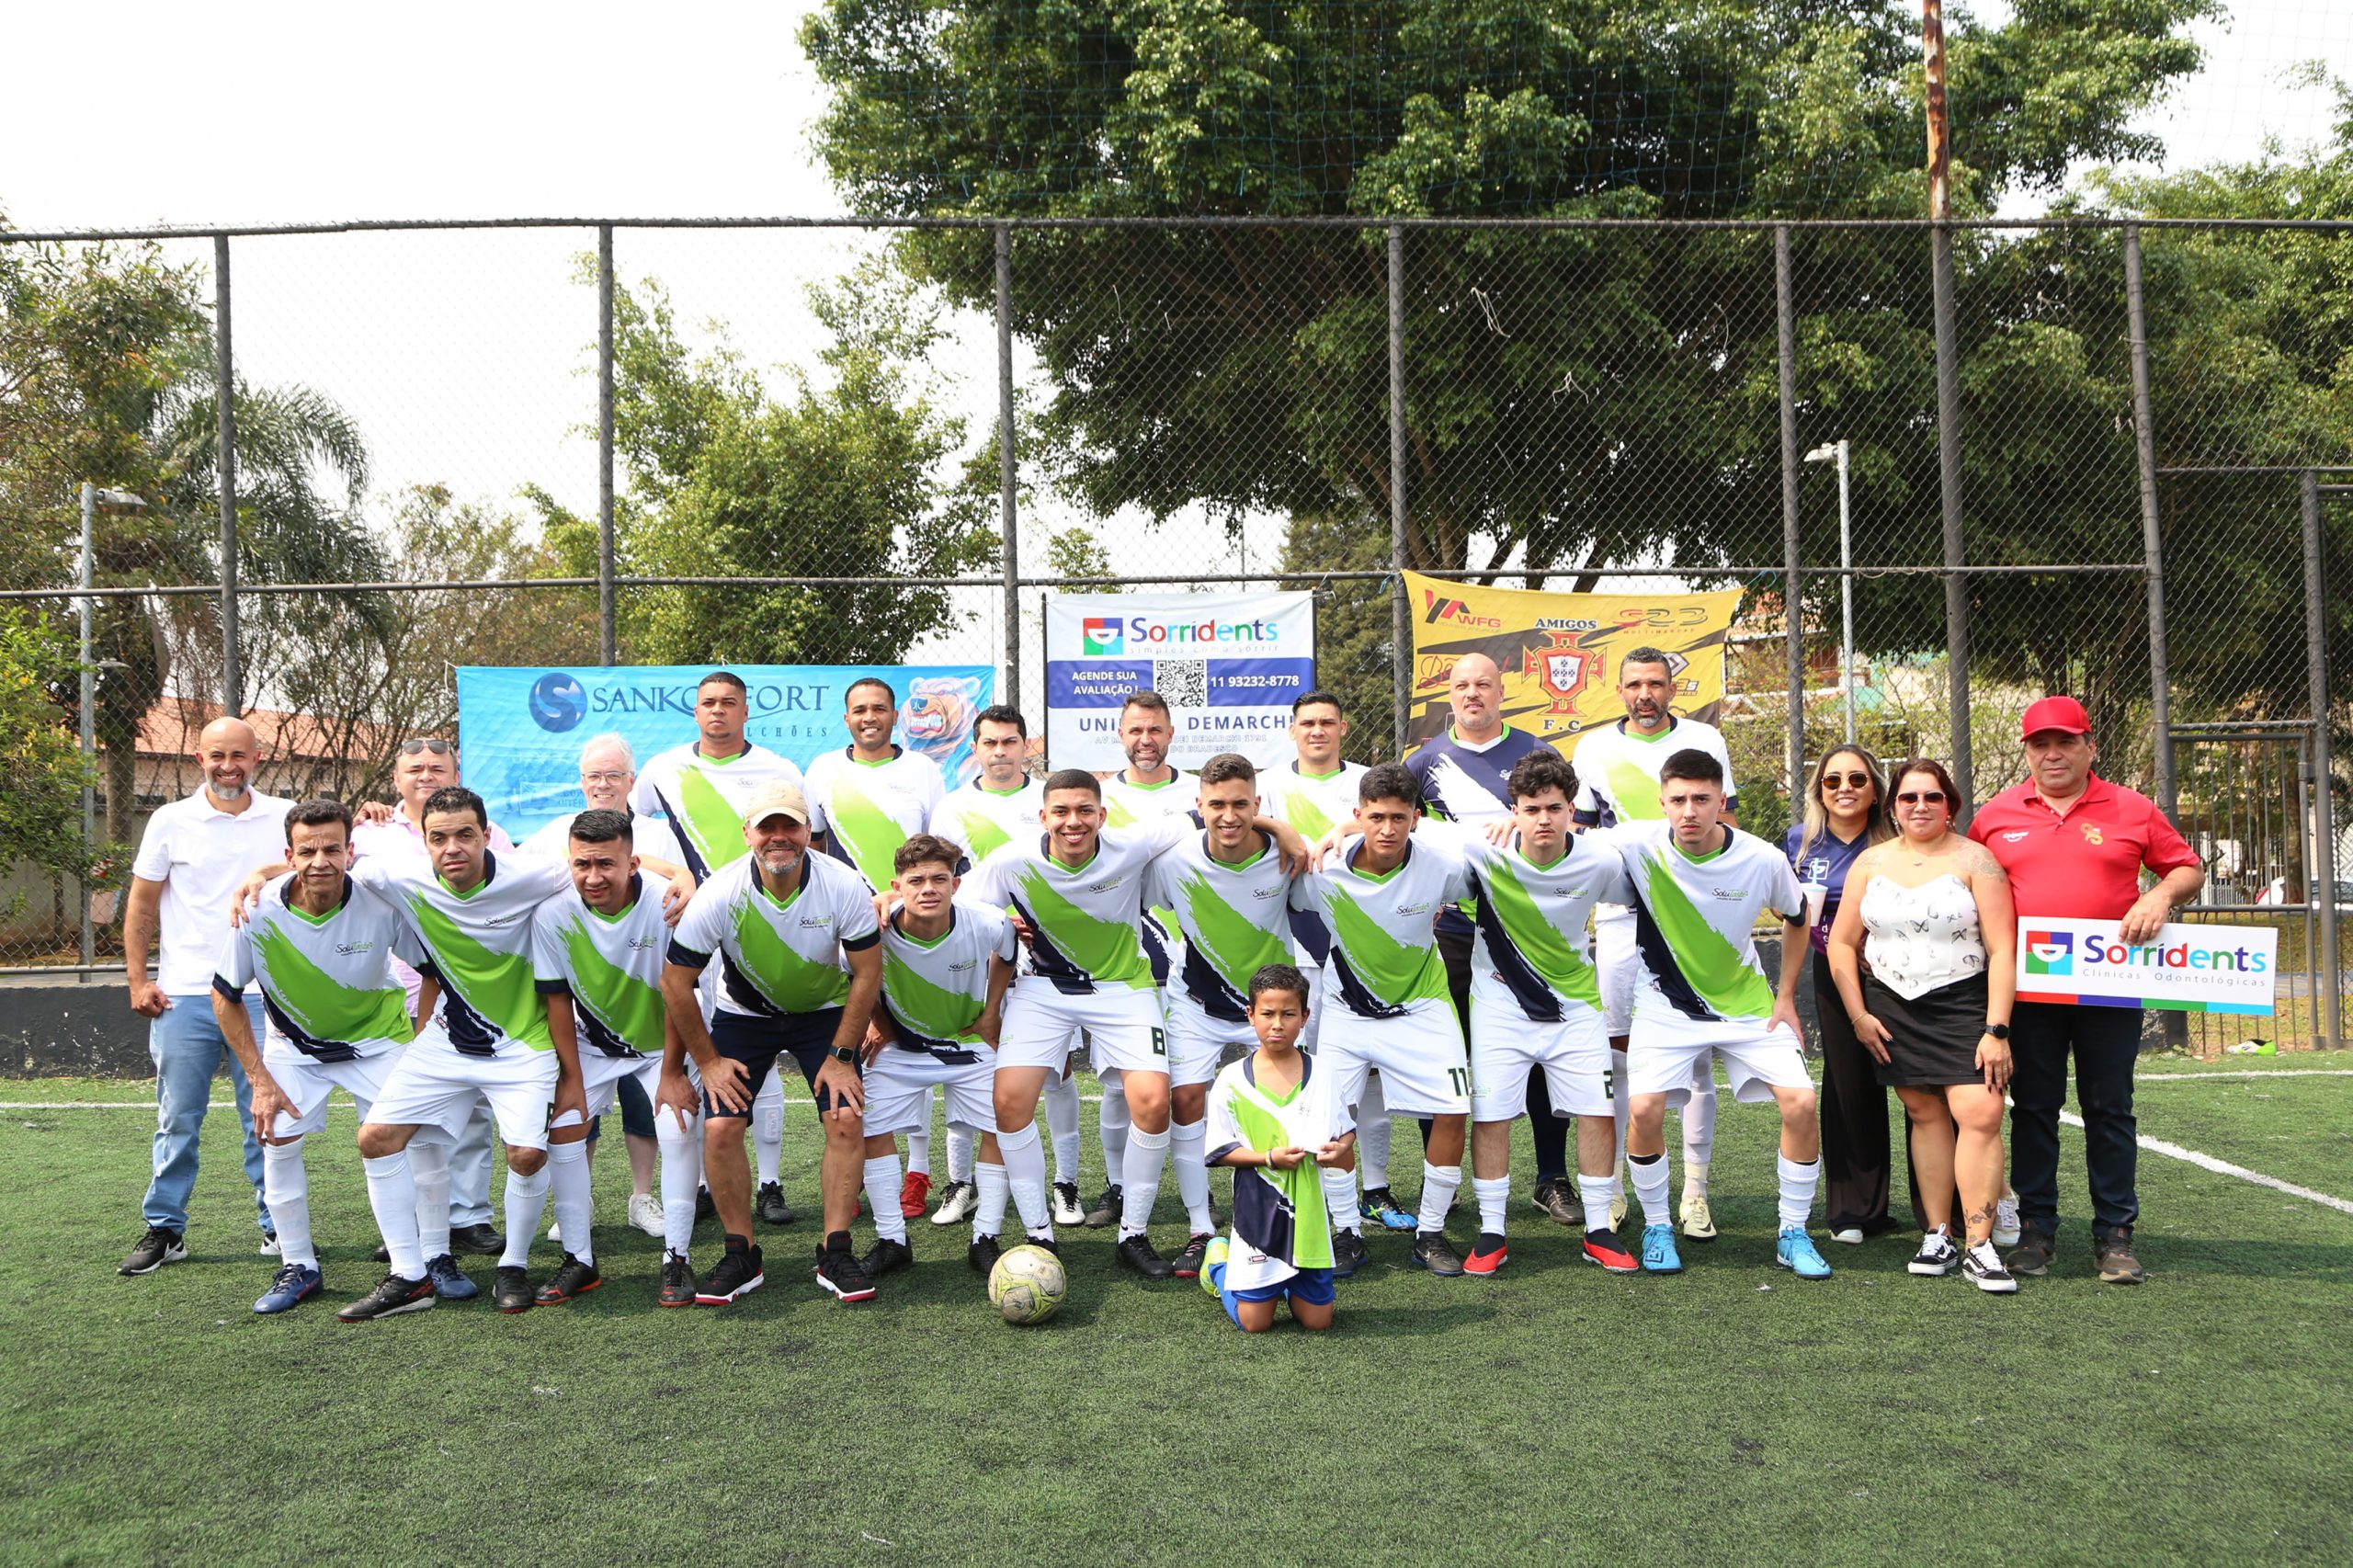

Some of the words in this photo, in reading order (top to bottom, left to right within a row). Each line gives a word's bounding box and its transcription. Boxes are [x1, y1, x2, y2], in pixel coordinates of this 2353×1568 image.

[1457, 614, 1501, 629] WFG
[1535, 618, 1597, 630] AMIGOS
[1131, 618, 1279, 642] Sorridents
[1131, 645, 1185, 656] simples
[1193, 642, 1229, 654] como
[1238, 640, 1279, 653] sorrir
[1072, 672, 1114, 681] AGENDE
[1116, 671, 1138, 680] SUA
[1211, 676, 1224, 687] 11
[1228, 675, 1300, 687] 93232-8778
[1074, 684, 1132, 697] AVALIAÇÃO
[1245, 733, 1267, 743] 1791
[1187, 744, 1239, 753] BRADESCO
[2084, 935, 2267, 972] Sorridents
[1448, 1066, 1470, 1096] 11
